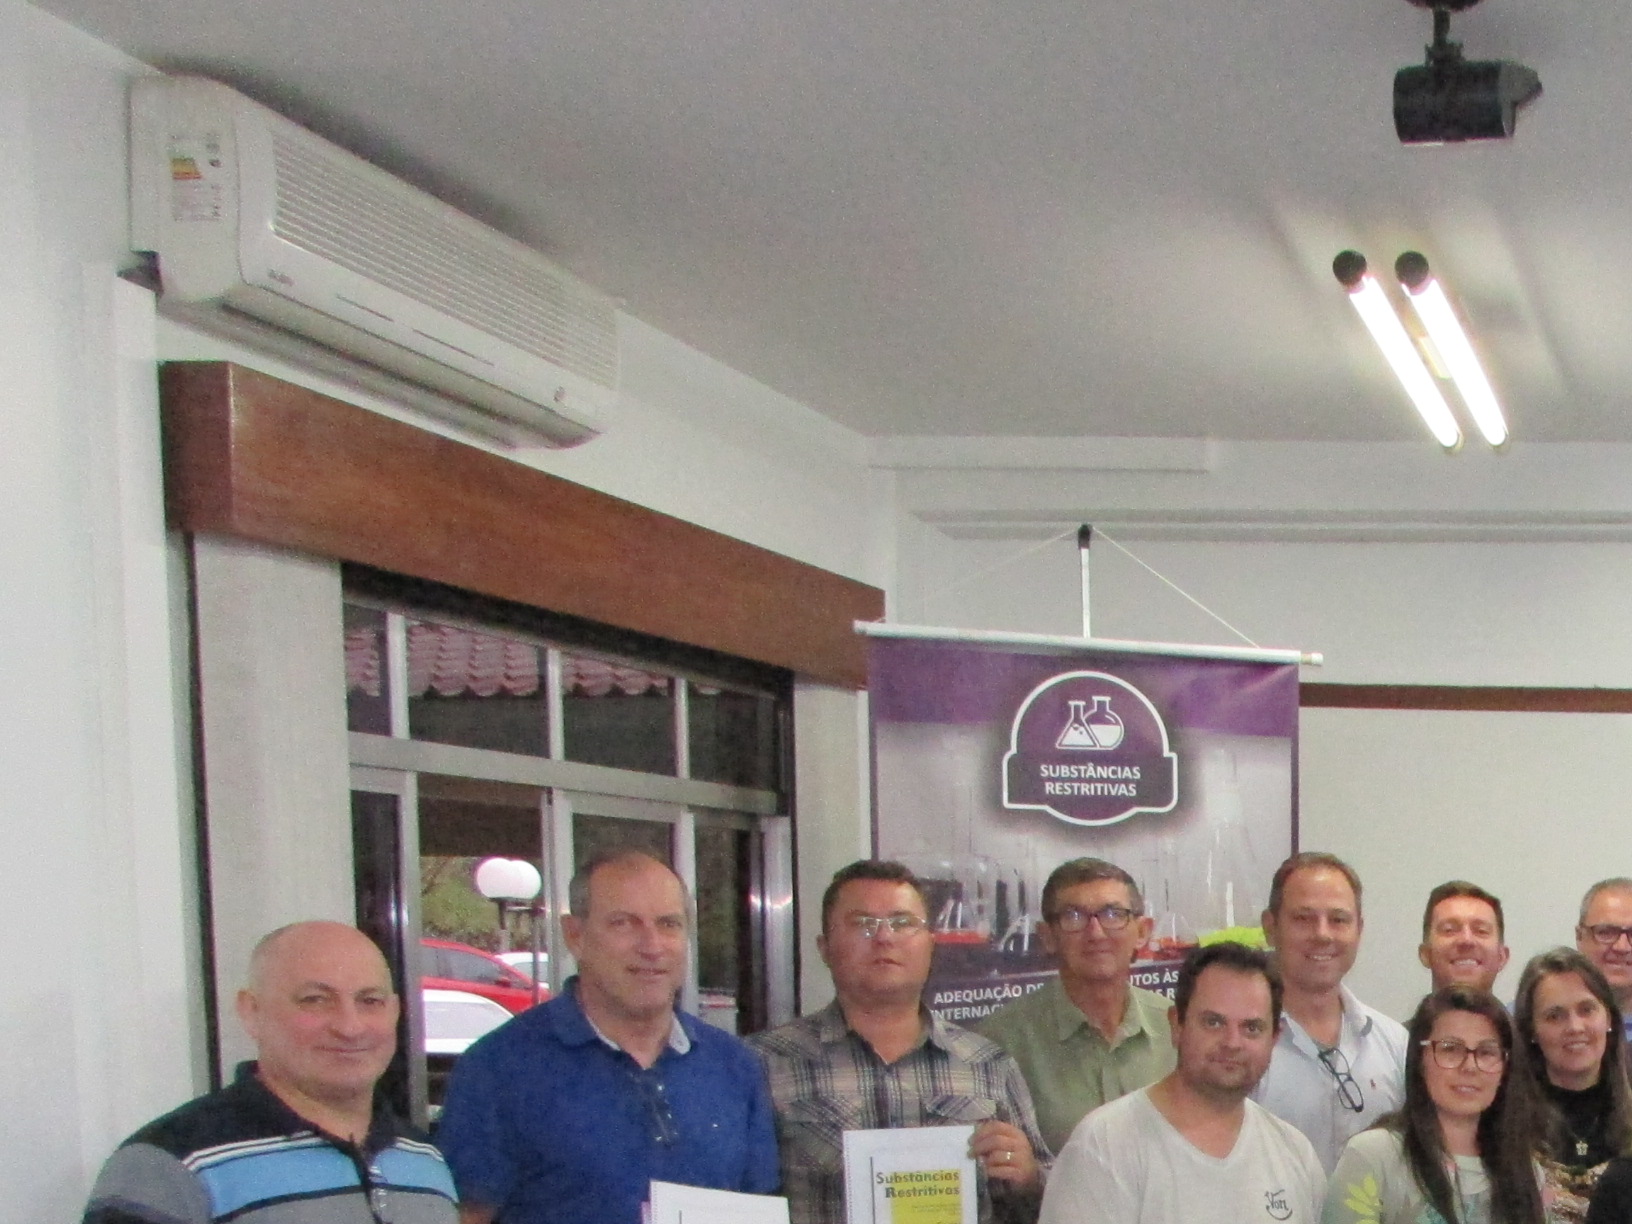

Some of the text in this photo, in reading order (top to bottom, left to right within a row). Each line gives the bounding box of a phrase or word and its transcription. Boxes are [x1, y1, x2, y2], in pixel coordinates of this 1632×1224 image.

[1040, 763, 1141, 779] SUBSTÂNCIAS
[1045, 781, 1137, 797] RESTRITIVAS
[934, 983, 1022, 1004] ADEQUAÇÃO
[876, 1169, 960, 1184] Substâncias
[885, 1184, 960, 1198] Restritivas
